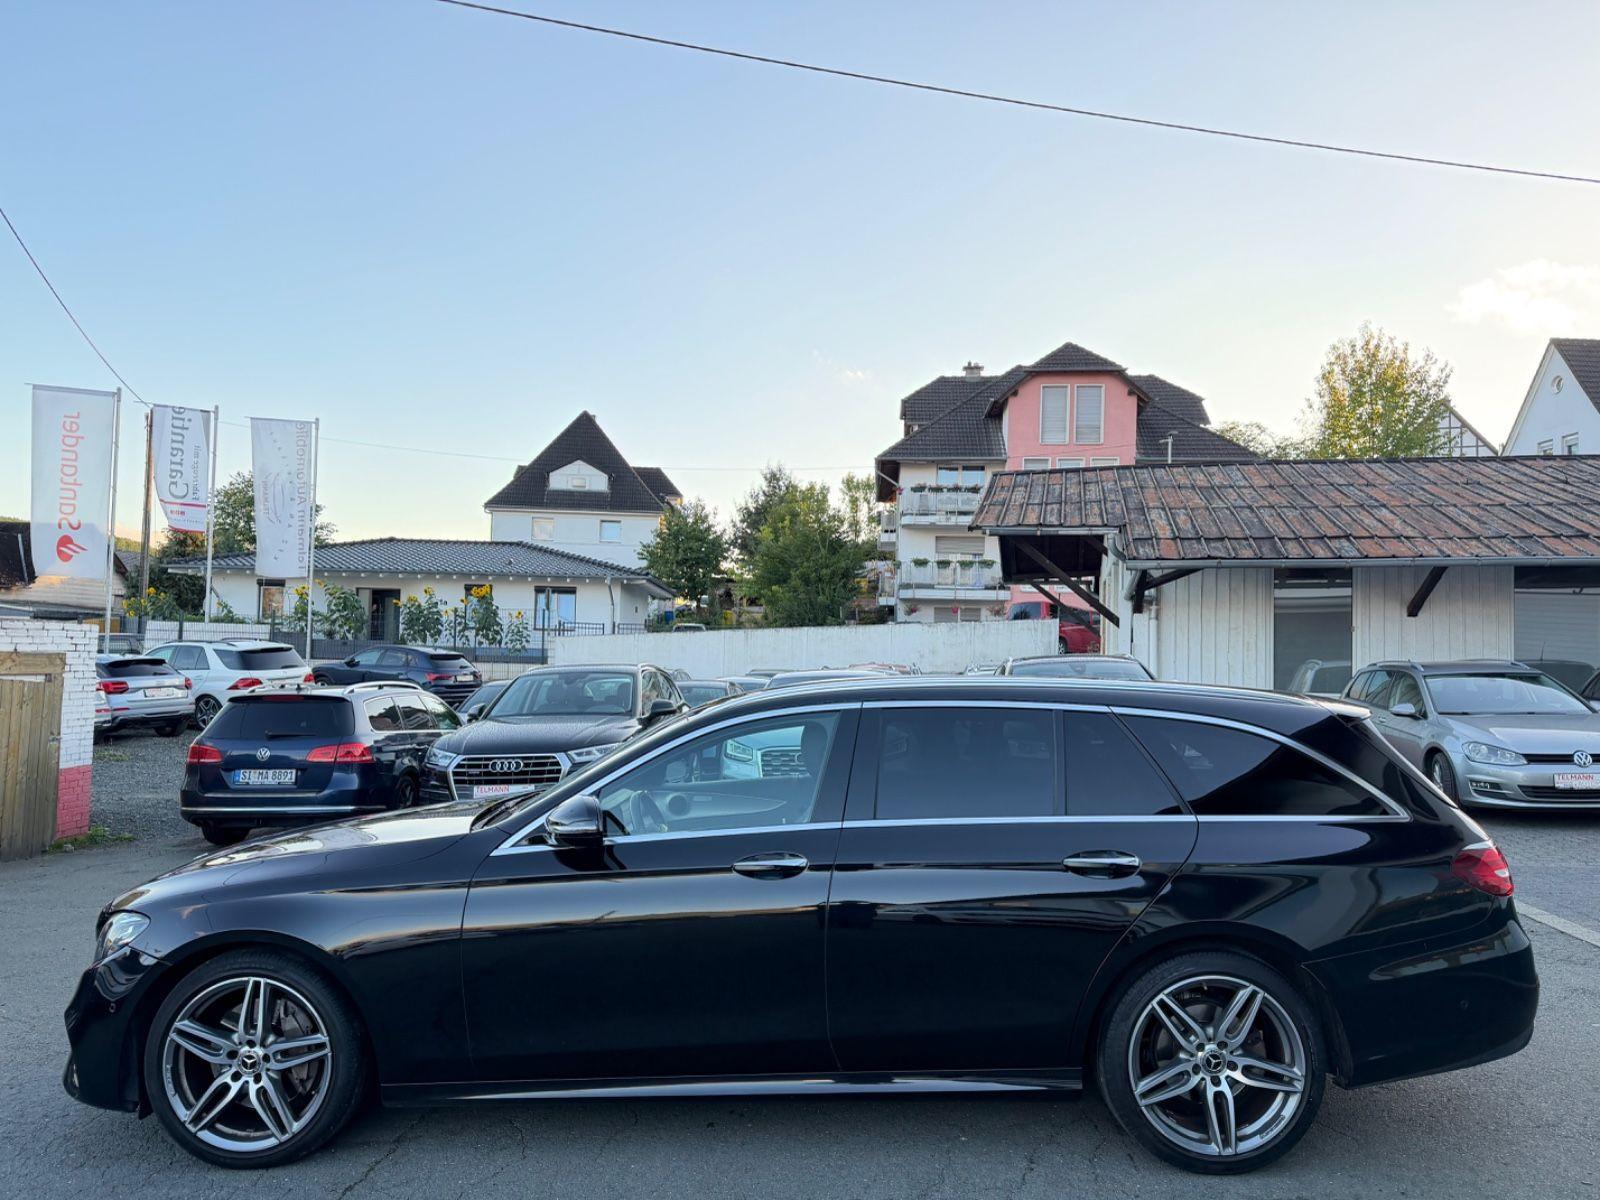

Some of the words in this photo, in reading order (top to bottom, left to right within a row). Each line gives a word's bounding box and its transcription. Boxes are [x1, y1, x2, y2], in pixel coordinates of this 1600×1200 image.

[241, 770, 252, 781] SI
[257, 770, 269, 780] MA
[1557, 773, 1595, 781] TELMANN
[476, 784, 510, 794] TELMANN
